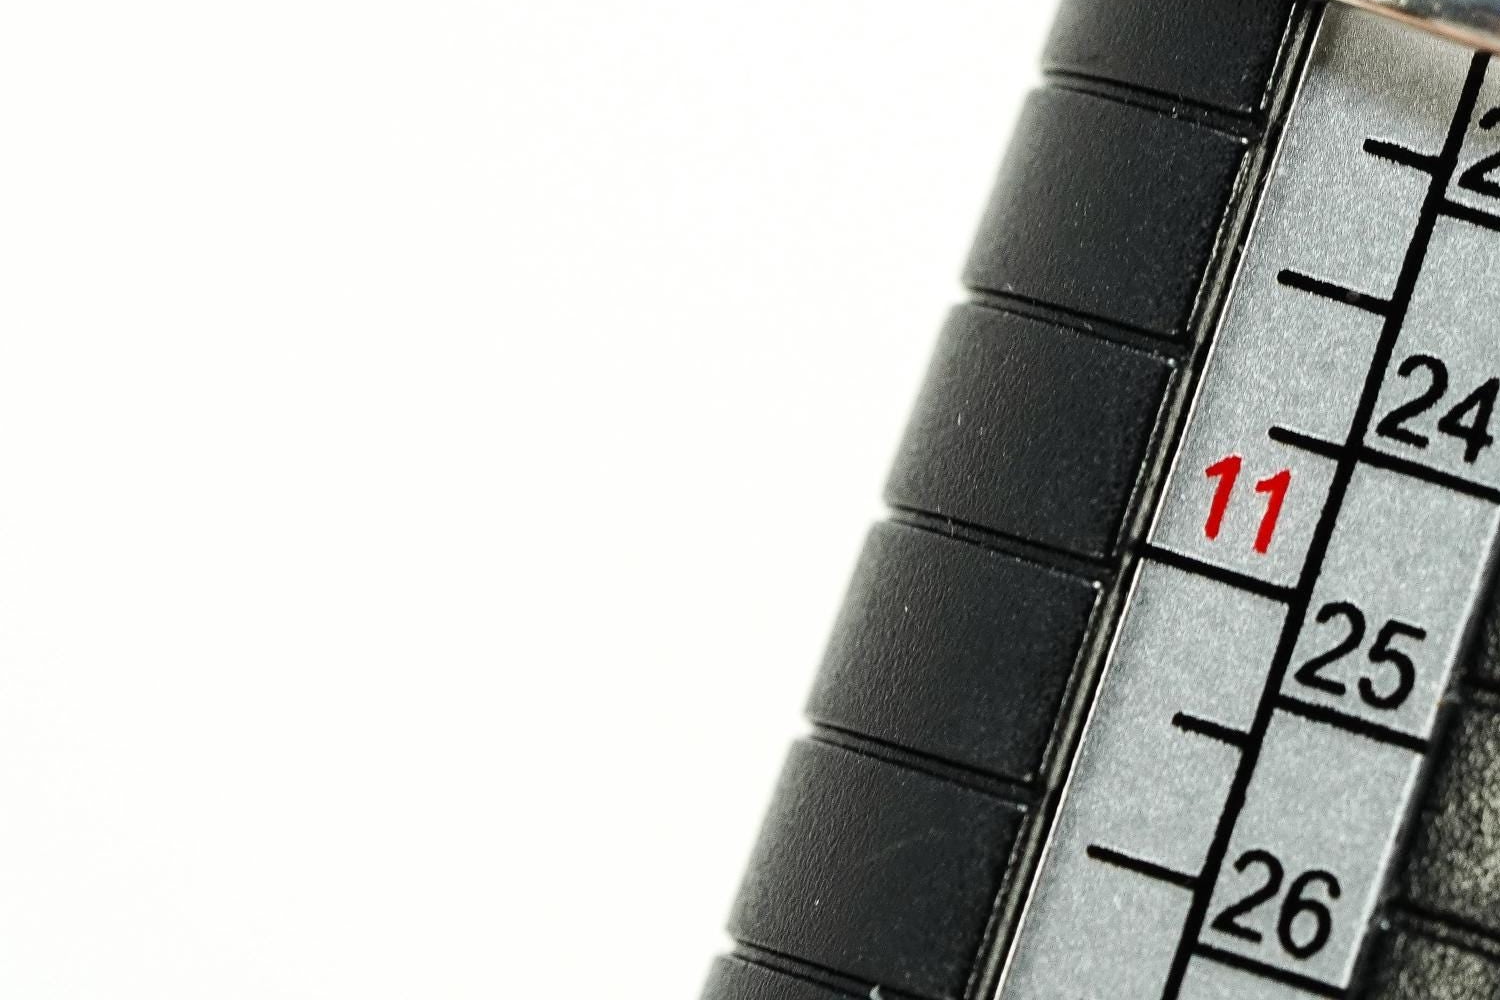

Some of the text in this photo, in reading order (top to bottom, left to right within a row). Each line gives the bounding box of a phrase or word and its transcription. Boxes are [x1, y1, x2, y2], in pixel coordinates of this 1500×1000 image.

[1375, 353, 1500, 465] 24
[1203, 455, 1292, 555] 11
[1293, 600, 1427, 711] 25
[1210, 849, 1341, 961] 26
